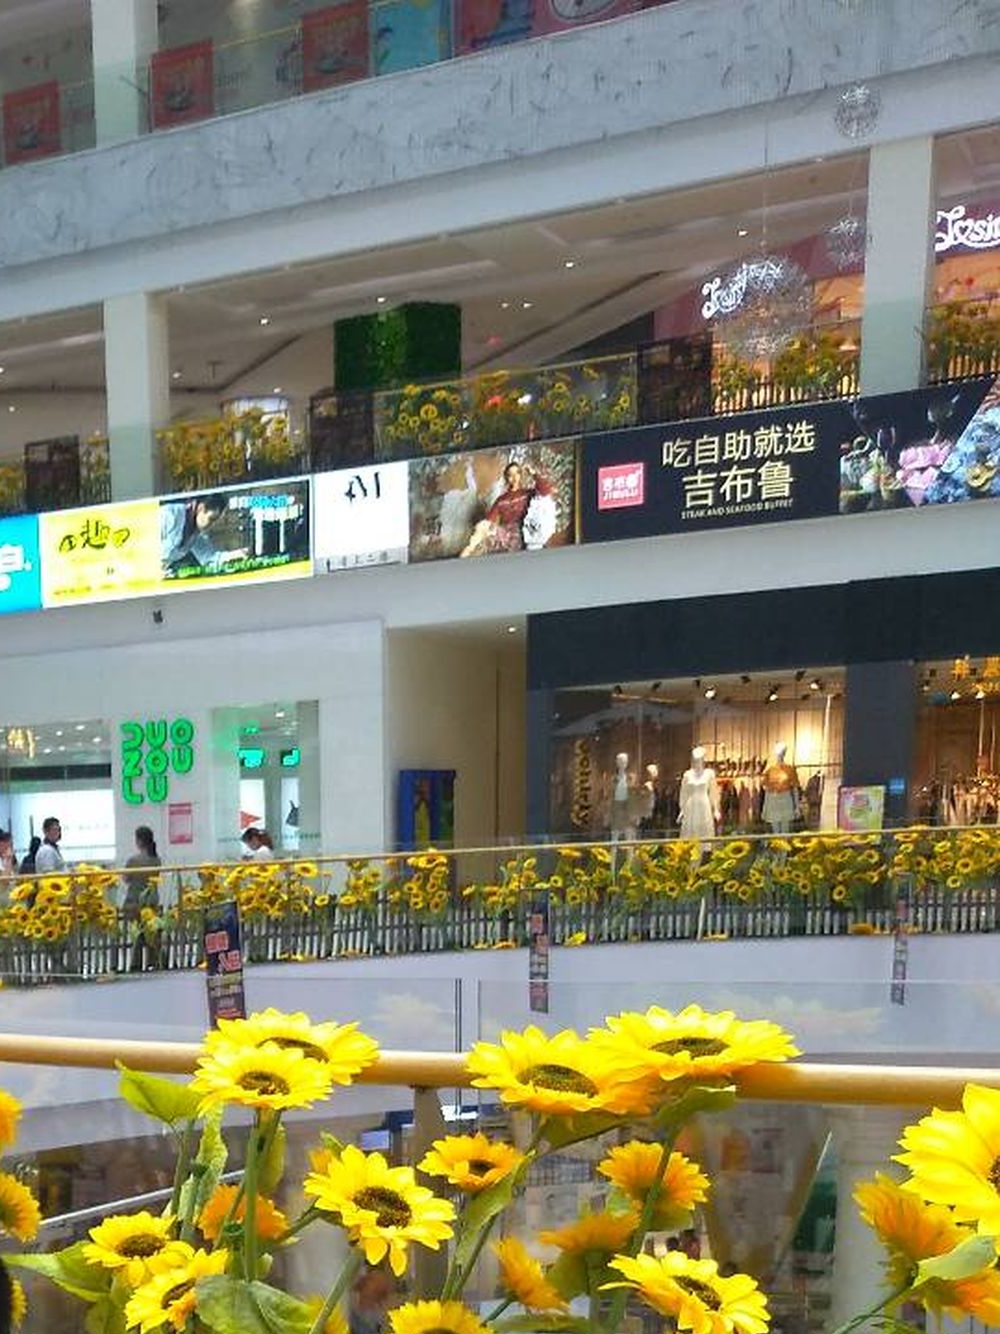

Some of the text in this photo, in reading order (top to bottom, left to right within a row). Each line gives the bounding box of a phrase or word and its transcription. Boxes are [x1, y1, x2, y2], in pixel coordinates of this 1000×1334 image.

[662, 420, 815, 468] 吃自助就选
[682, 460, 794, 508] 吉布鲁
[706, 507, 725, 517] AND
[725, 502, 763, 515] SEAFOOD
[121, 744, 194, 778] ZOU
[121, 774, 169, 805] LU
